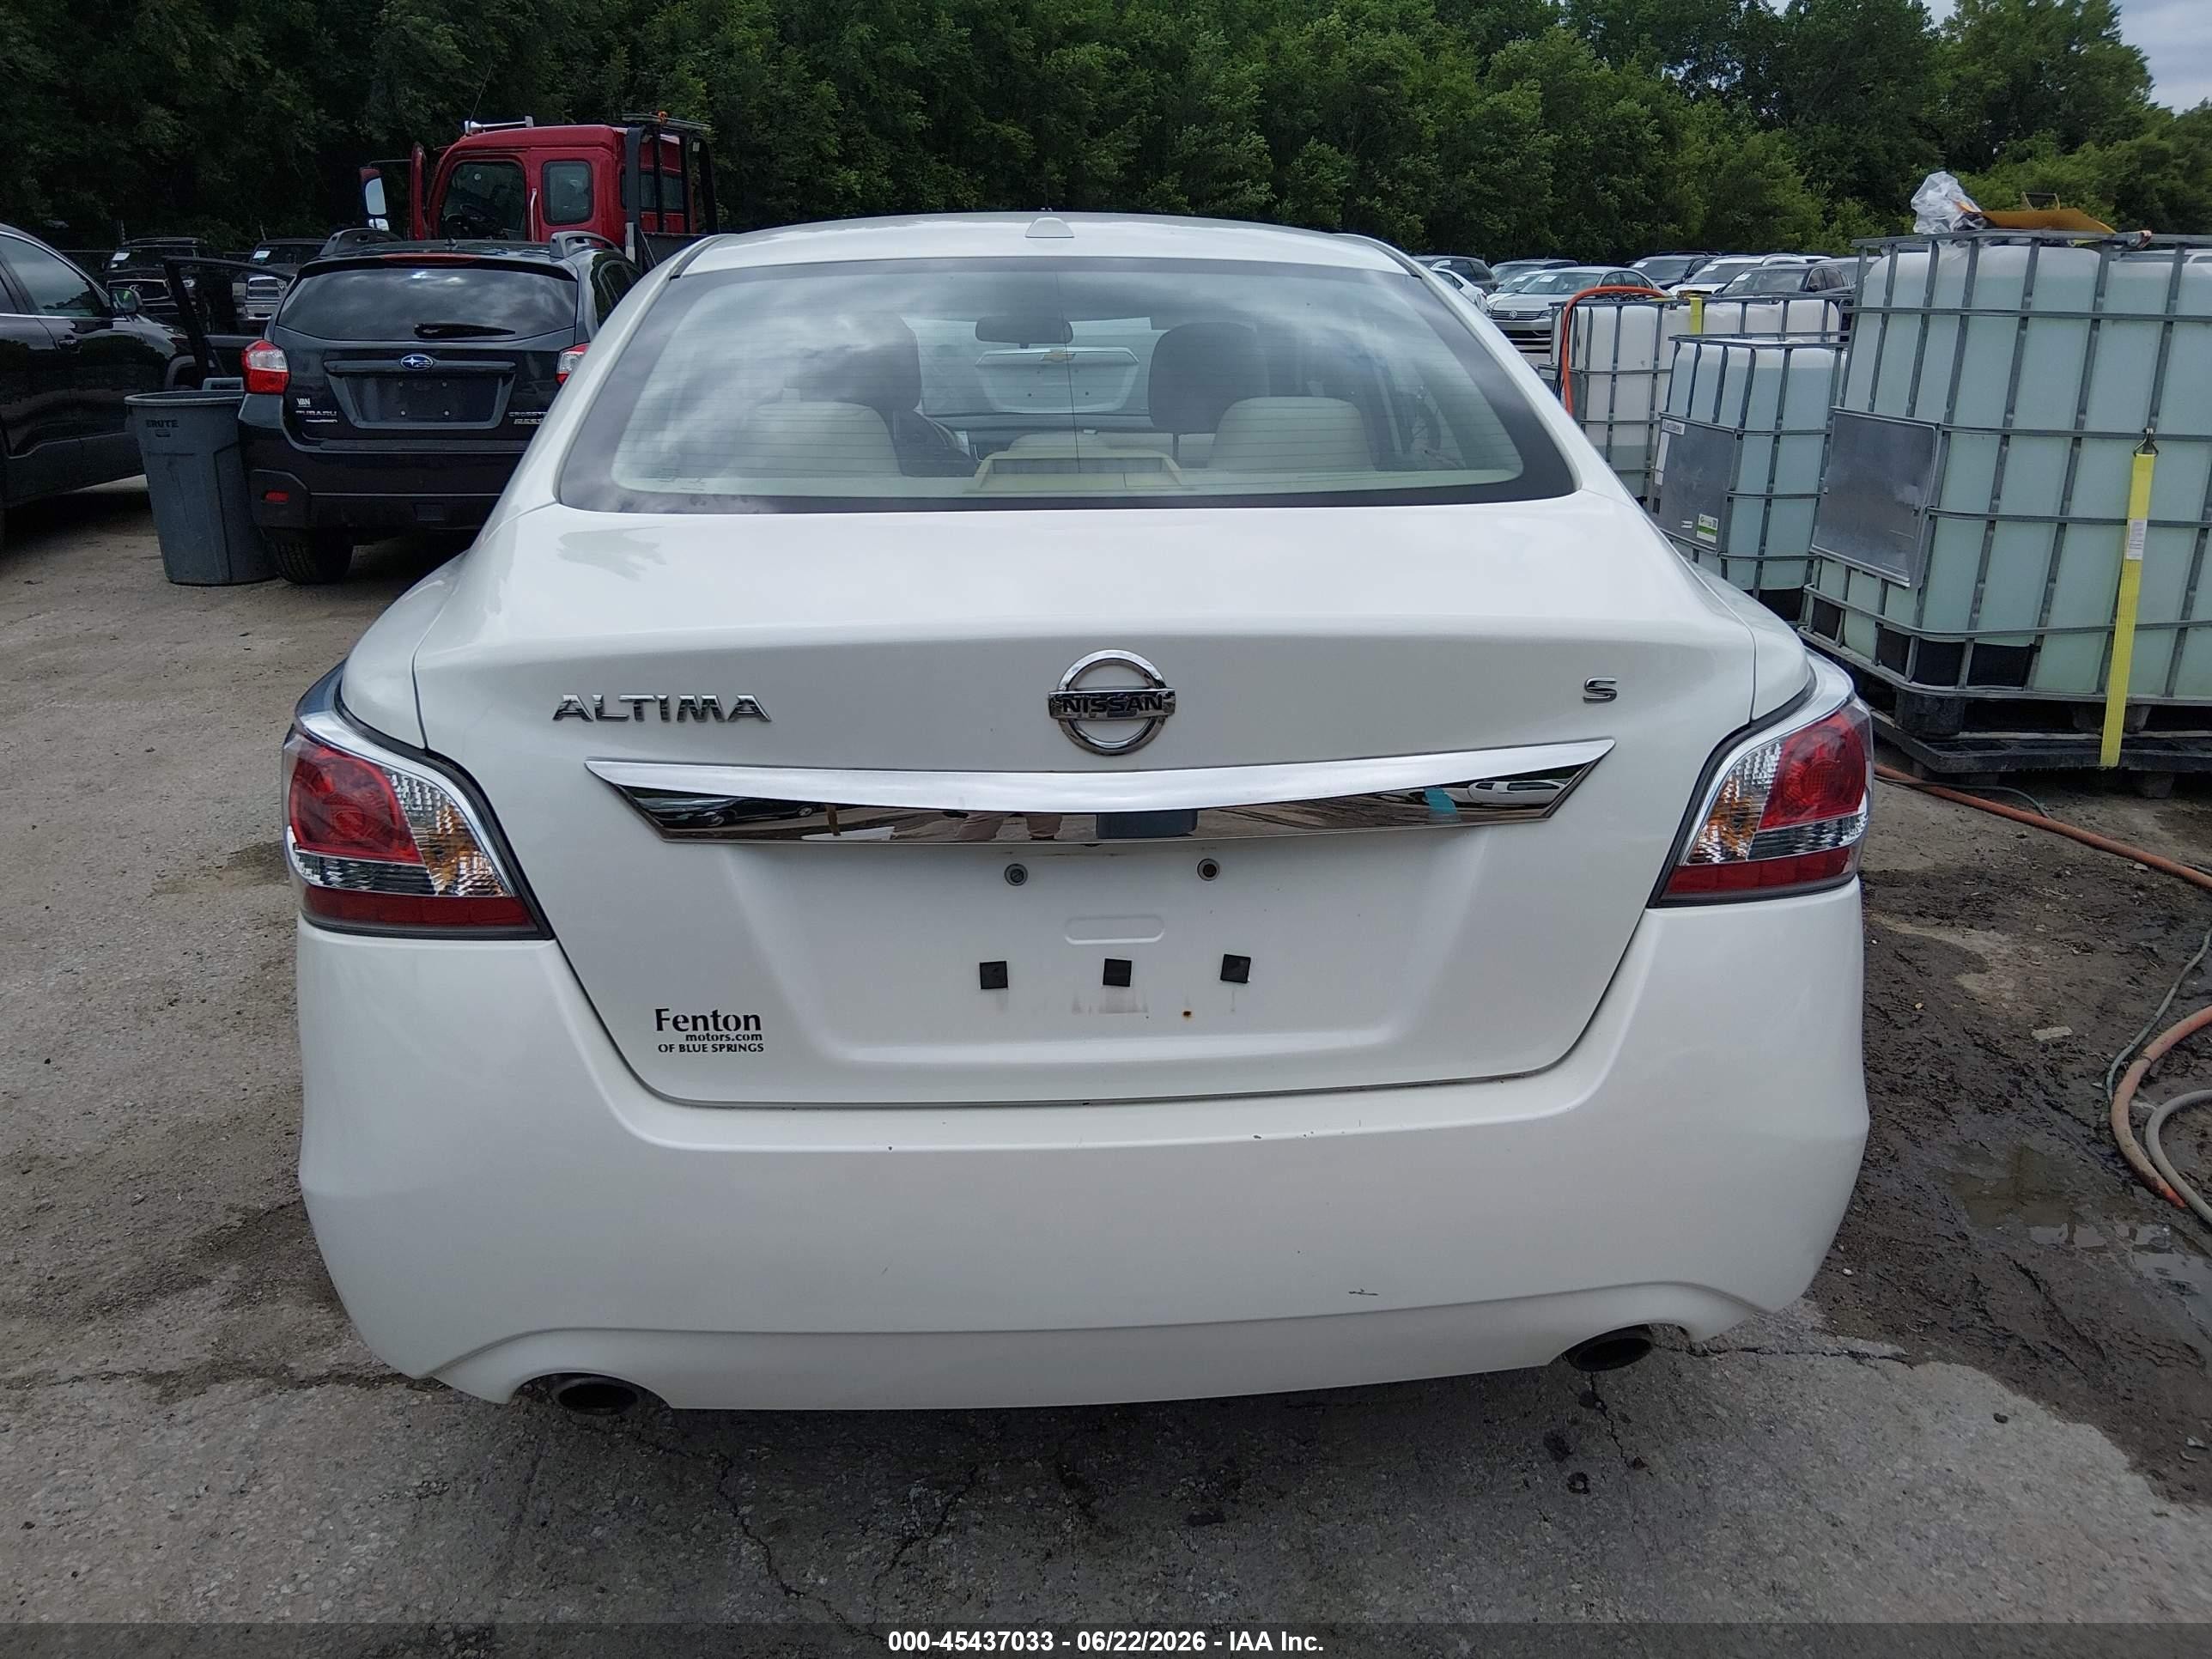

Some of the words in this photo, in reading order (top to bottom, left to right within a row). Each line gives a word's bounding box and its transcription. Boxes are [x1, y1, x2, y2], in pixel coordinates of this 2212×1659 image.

[1583, 677, 1618, 704] S
[552, 693, 772, 723] ALTIMA
[1061, 695, 1164, 714] NISSAN
[654, 1007, 762, 1032] Fenton
[658, 1043, 676, 1053] OF
[678, 1043, 708, 1053] BLUE
[711, 1042, 764, 1053] SPRINGS
[685, 1032, 763, 1042] motors.com
